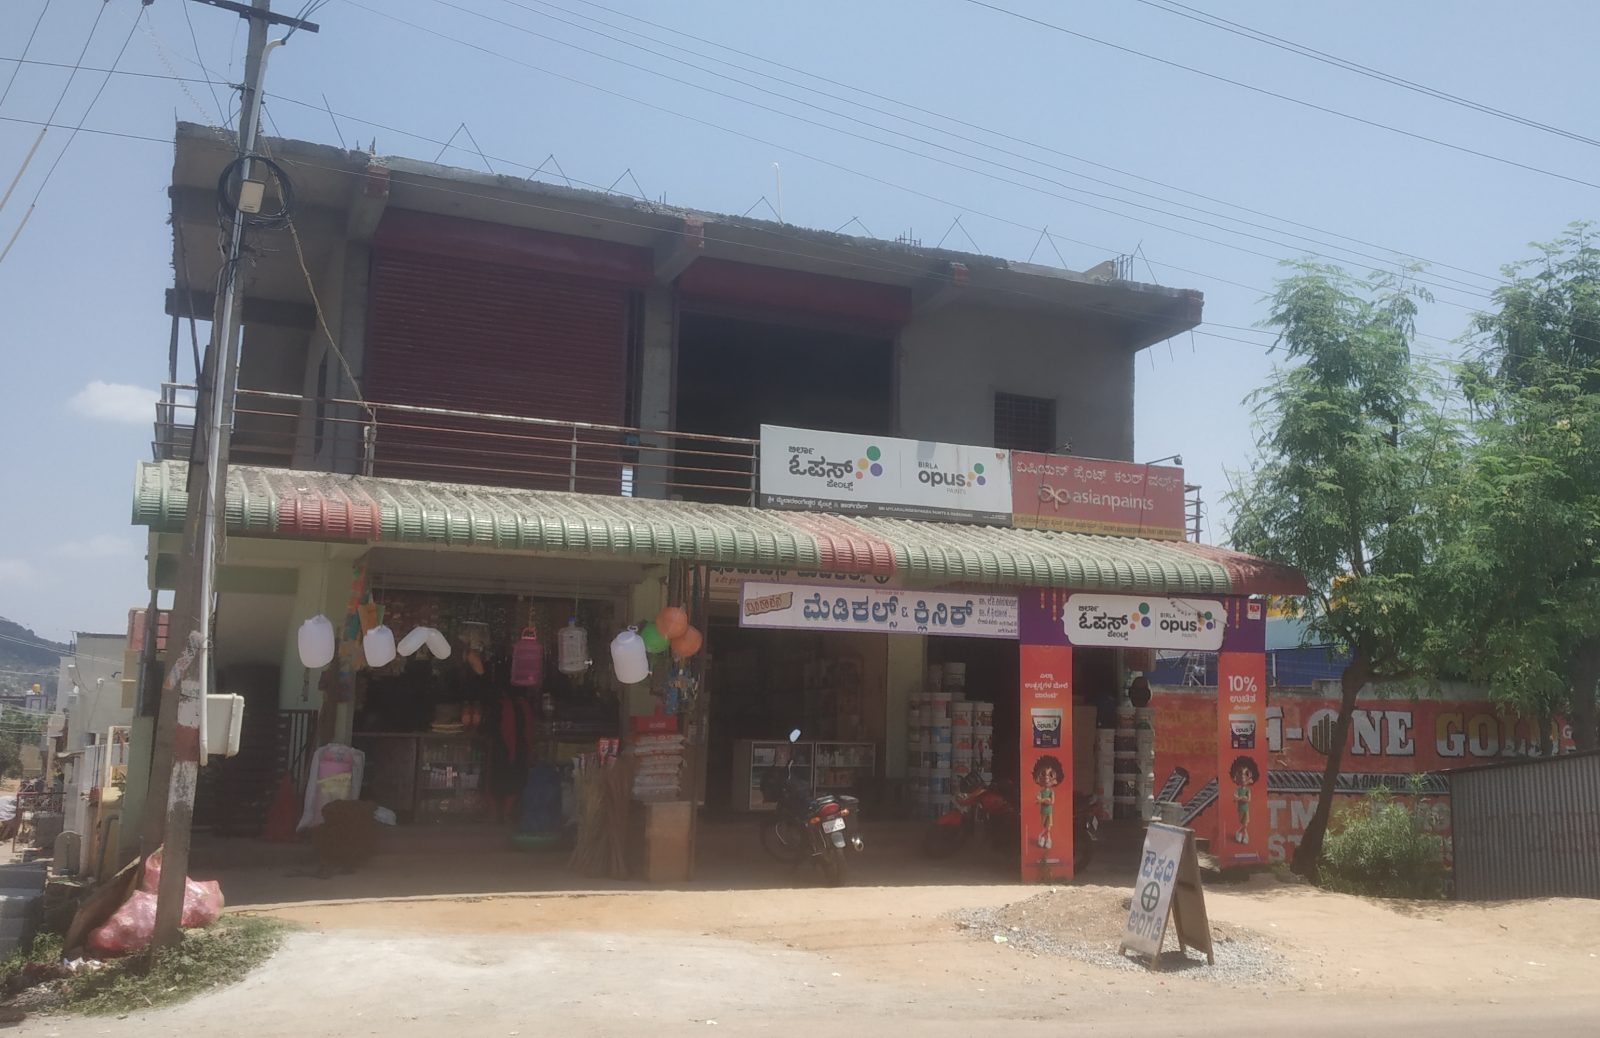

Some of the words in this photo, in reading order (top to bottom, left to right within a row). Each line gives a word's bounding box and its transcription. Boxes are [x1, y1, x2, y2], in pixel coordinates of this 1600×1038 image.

[788, 454, 854, 479] ಓಪಸ್
[918, 461, 939, 470] BIRLA
[918, 470, 966, 487] opus
[1114, 471, 1145, 484] ಕಲರ್
[1072, 489, 1154, 513] asianpaints
[803, 592, 899, 629] ಮೆಡಿಕಲ್ಸ್
[913, 599, 974, 634] ಕ್ಲಿನಿಕ್
[1078, 611, 1129, 630] ಓಪಸ್
[1159, 618, 1197, 634] opus
[1228, 675, 1258, 693] 10%
